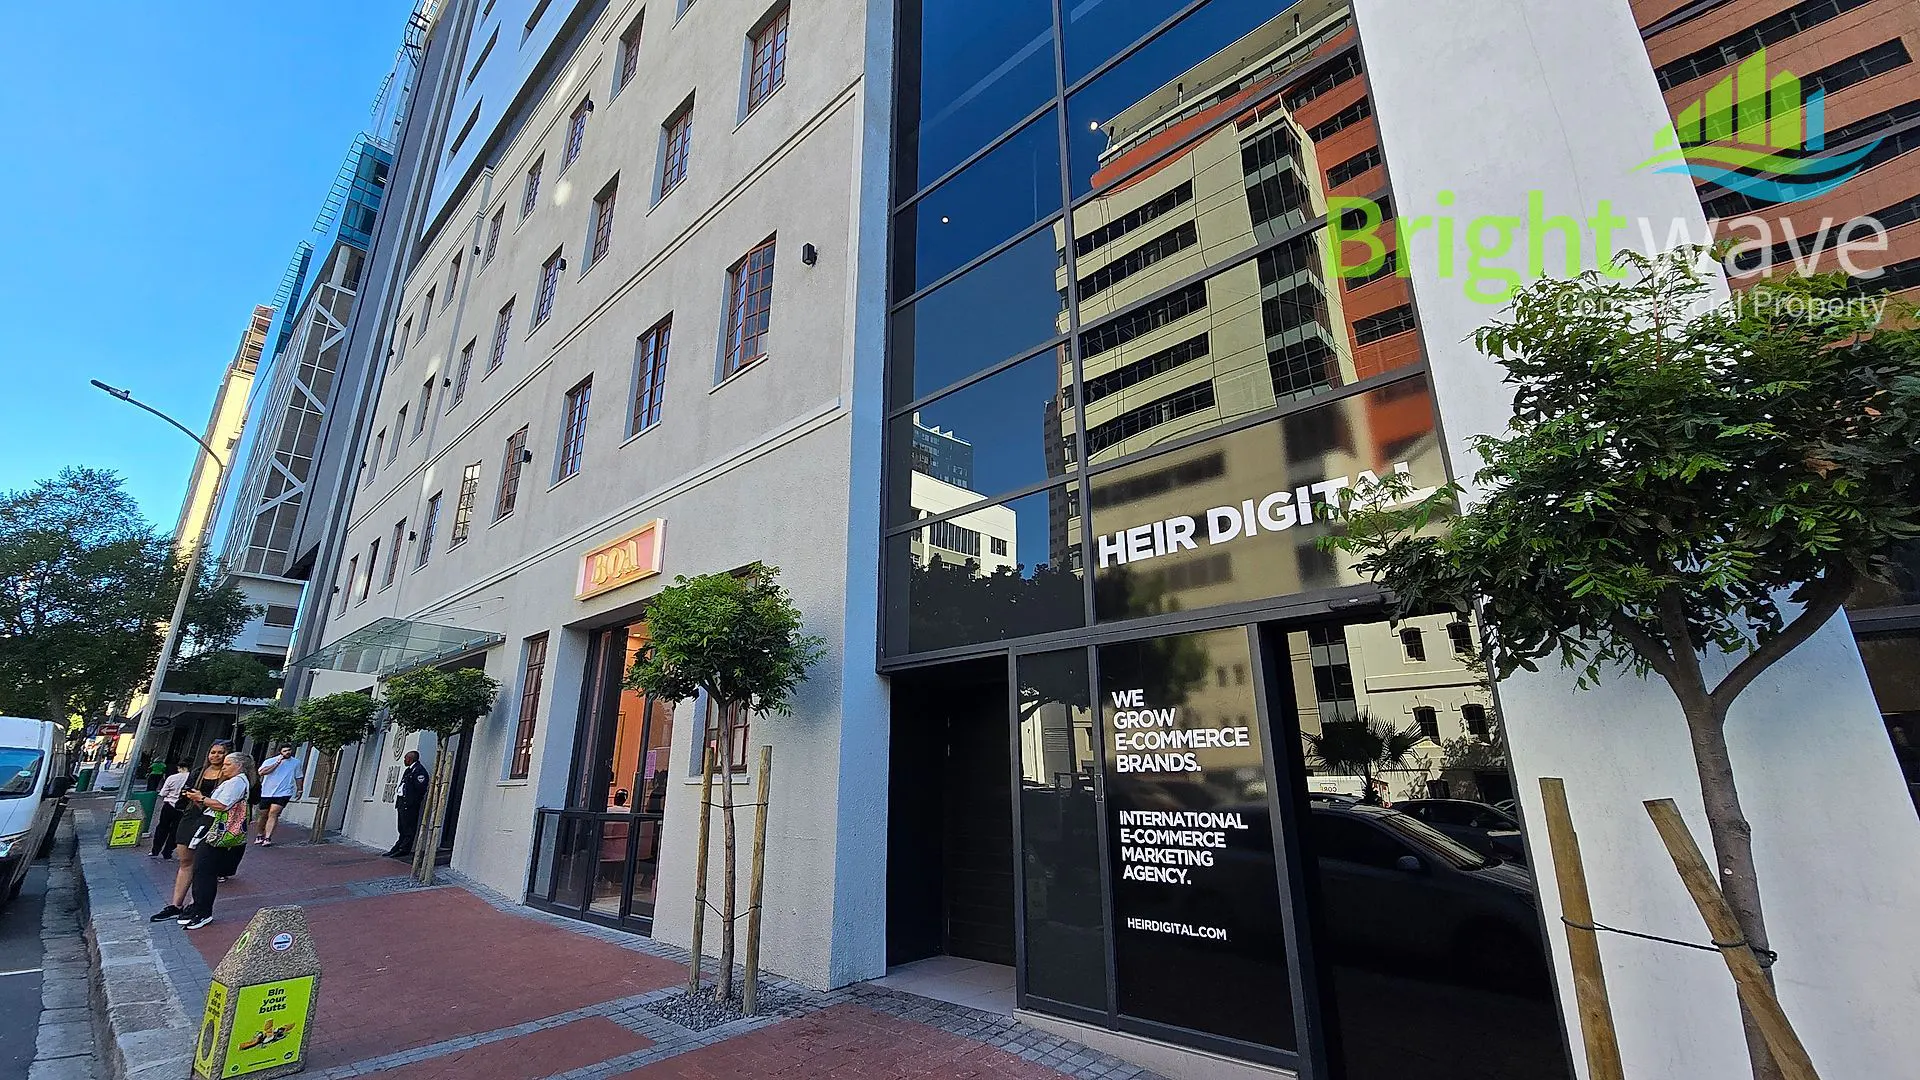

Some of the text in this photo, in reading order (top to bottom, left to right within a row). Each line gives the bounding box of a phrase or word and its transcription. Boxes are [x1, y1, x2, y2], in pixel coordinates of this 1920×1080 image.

[1098, 462, 1437, 569] HEIR DIGITAL
[591, 540, 640, 585] BOA
[1112, 689, 1144, 708] WE
[1113, 707, 1176, 730] GROW
[1114, 726, 1250, 751] E-COMMERCE
[1116, 752, 1202, 773] BRANDS.
[1119, 810, 1249, 829] INTERNATIONAL
[1120, 828, 1226, 848] E-COMMERCE
[1121, 846, 1214, 867] MARKETING
[1122, 864, 1192, 885] AGENCY.
[1127, 917, 1227, 941] HEIRDIGITAL.COM
[263, 995, 287, 1007] your
[267, 987, 285, 997] Bin
[258, 1003, 287, 1015] butts
